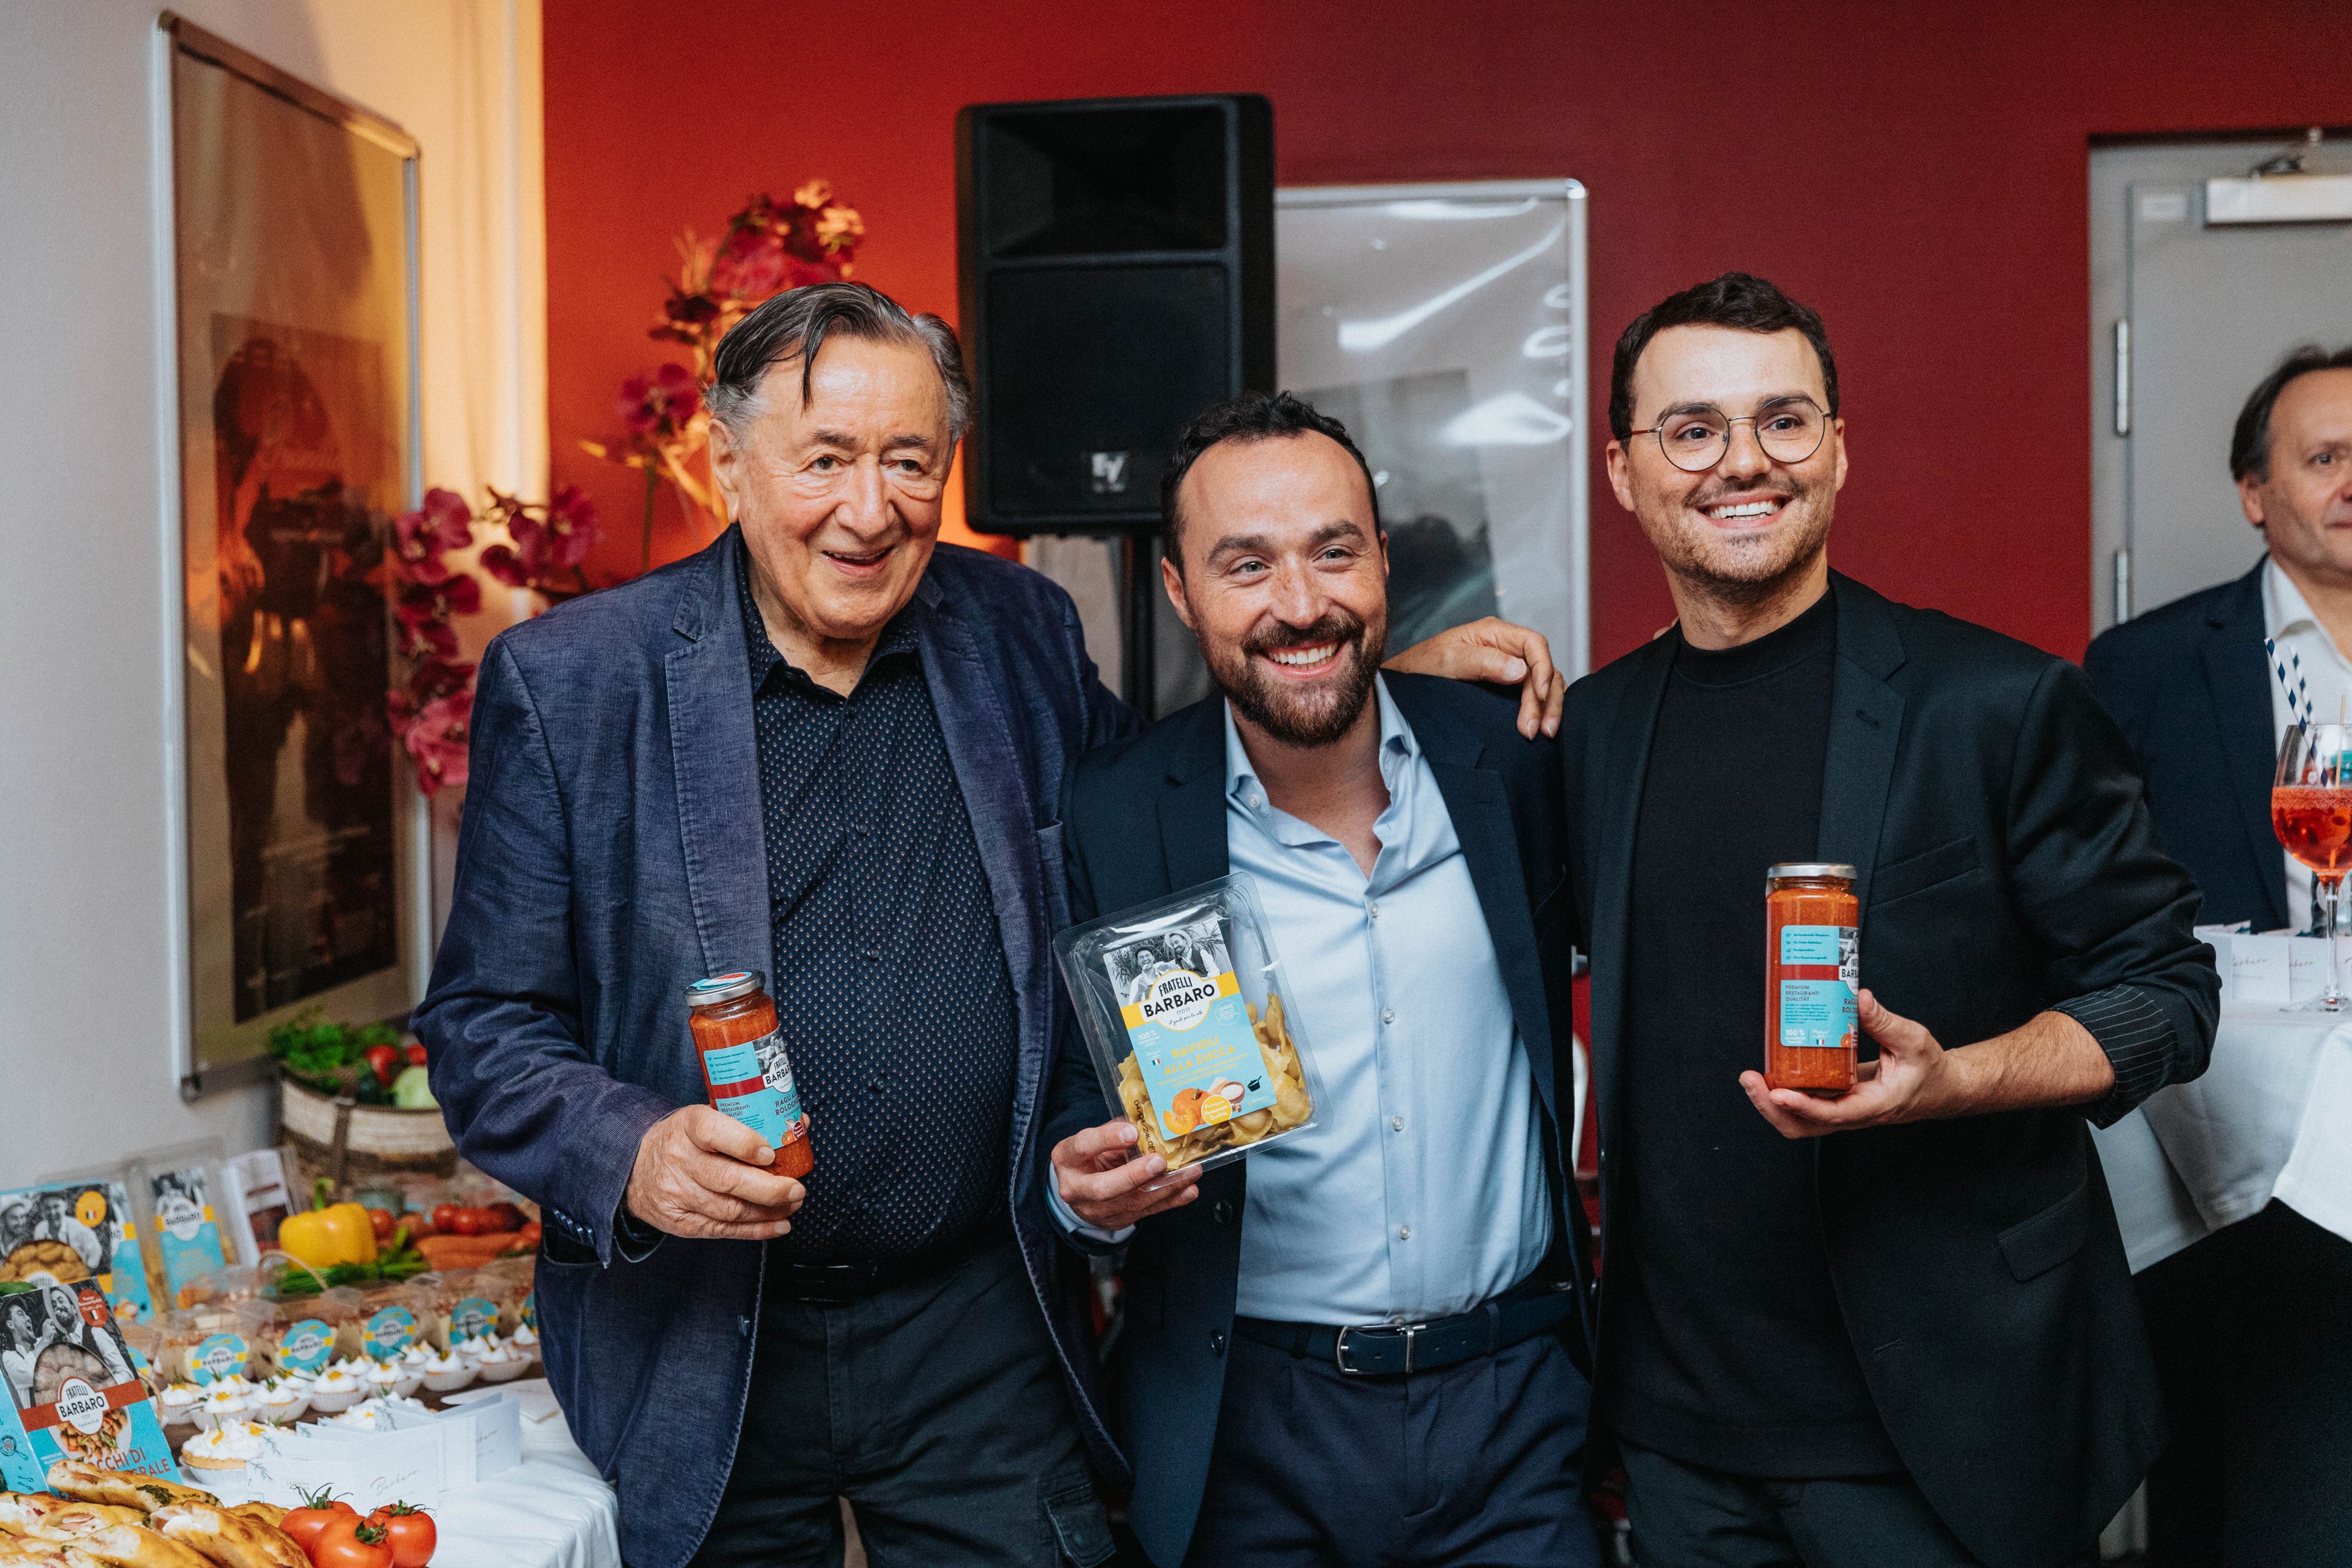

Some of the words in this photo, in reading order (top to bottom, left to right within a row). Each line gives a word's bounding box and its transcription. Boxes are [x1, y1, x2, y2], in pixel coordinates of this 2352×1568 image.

[1158, 976, 1192, 997] FRATELLI
[1144, 984, 1215, 1017] BARBARO
[1138, 1032, 1150, 1040] 100
[1171, 1035, 1220, 1058] RAVIOLI
[1165, 1059, 1194, 1075] ALLA
[1195, 1045, 1236, 1065] ZUCCA
[766, 1064, 790, 1085] BARBAR
[721, 1104, 751, 1112] RESTAURANT-
[1205, 1100, 1225, 1108] Premium
[66, 1385, 89, 1400] FRATELLI
[59, 1396, 104, 1417] BARBARO
[129, 1447, 146, 1464] DI
